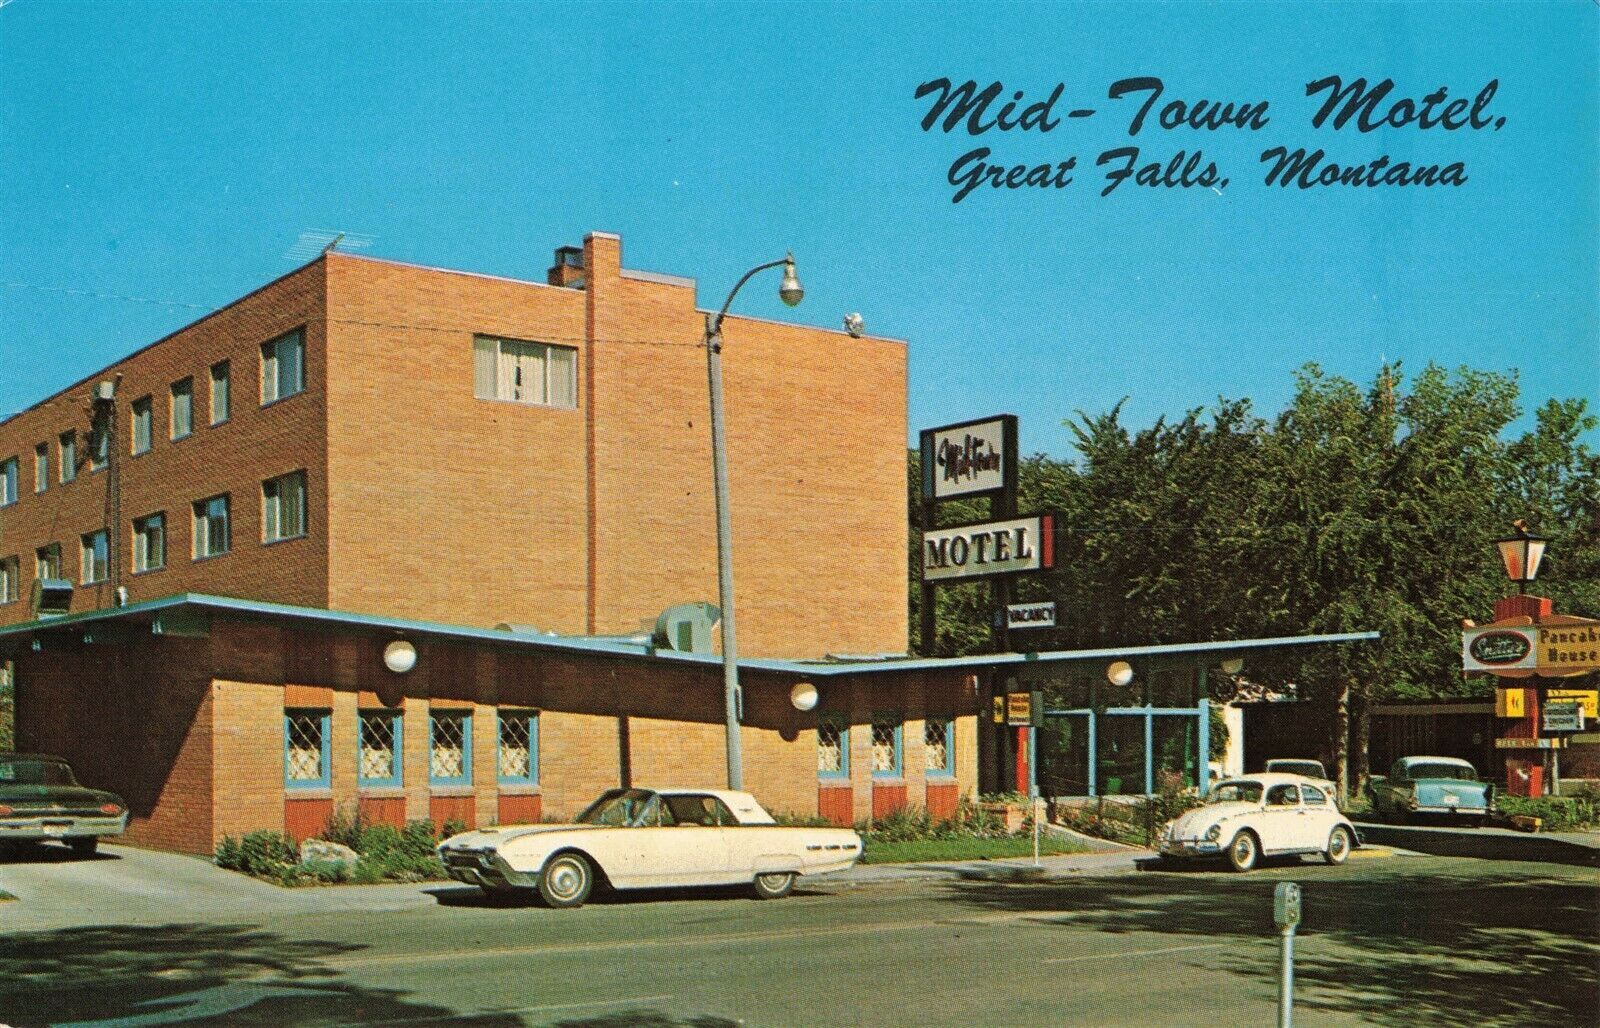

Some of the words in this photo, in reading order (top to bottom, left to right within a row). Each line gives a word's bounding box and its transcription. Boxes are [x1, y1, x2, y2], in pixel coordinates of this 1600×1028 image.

[926, 527, 1032, 569] MOTEL
[1008, 607, 1056, 623] VACANCY
[1541, 627, 1600, 643] Pancak
[1548, 647, 1597, 662] House
